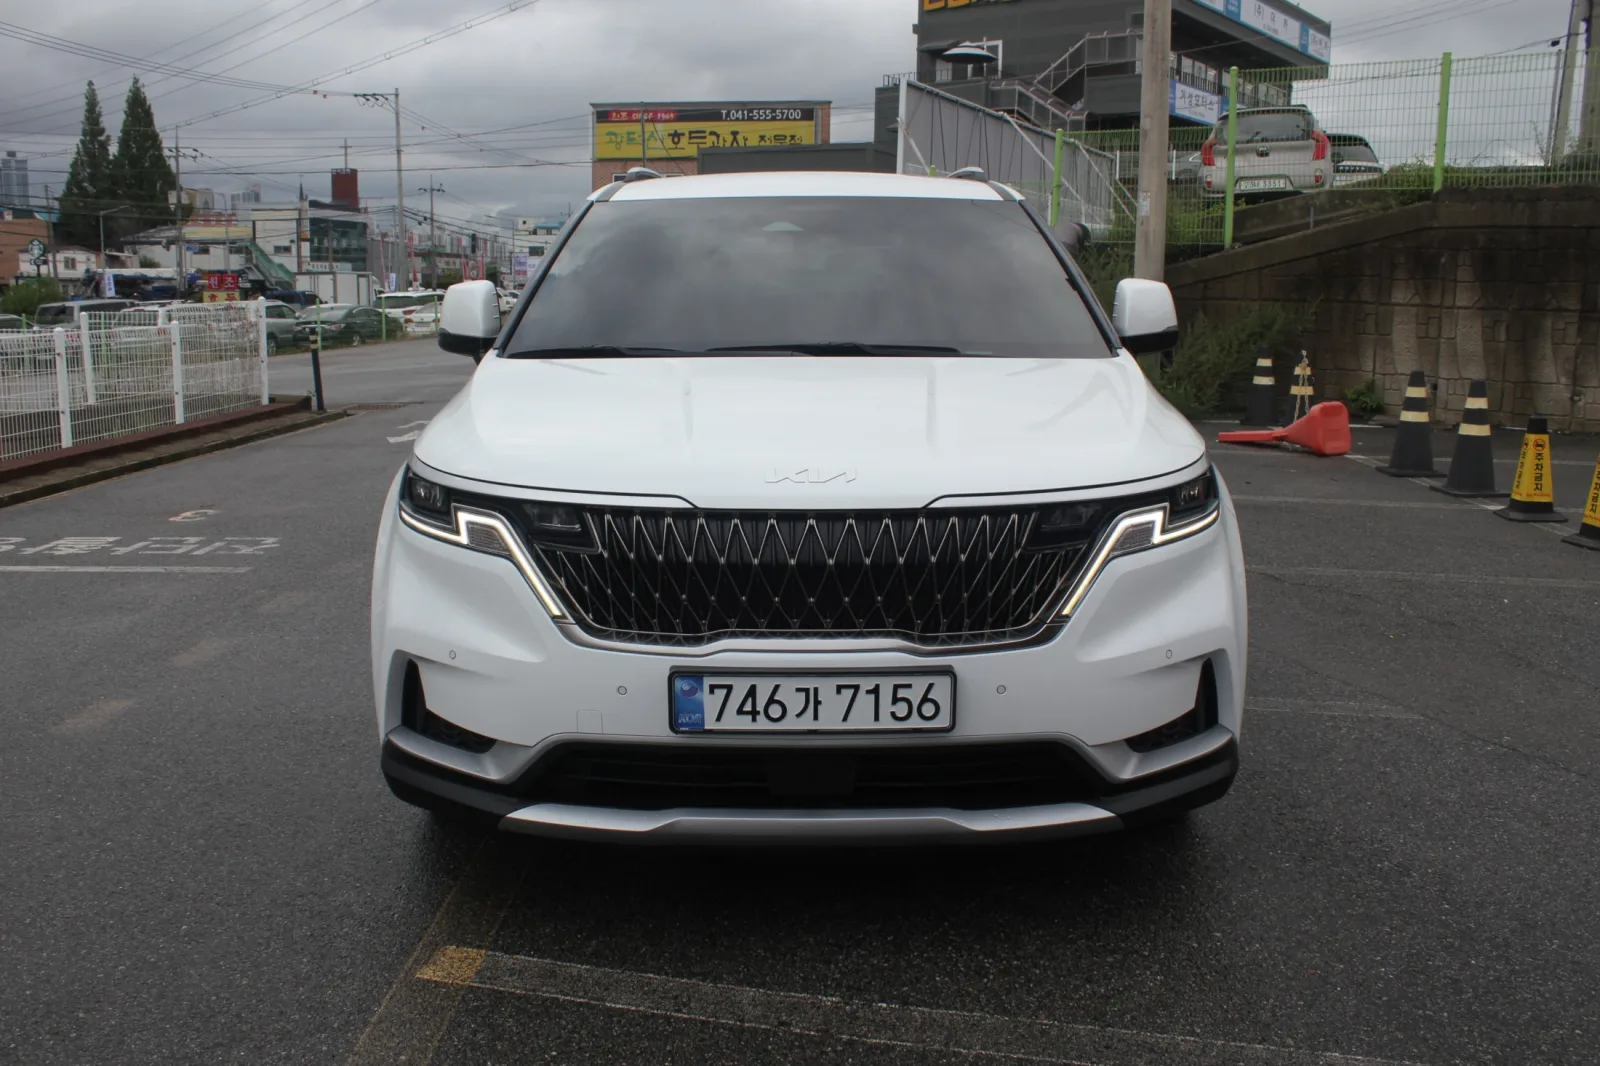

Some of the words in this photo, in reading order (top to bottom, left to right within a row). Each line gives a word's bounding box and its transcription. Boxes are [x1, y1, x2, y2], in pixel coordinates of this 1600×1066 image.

[721, 109, 801, 120] T.041-555-5700
[1534, 453, 1544, 491] 주차금지
[708, 683, 822, 723] 746가
[835, 682, 941, 722] 7156
